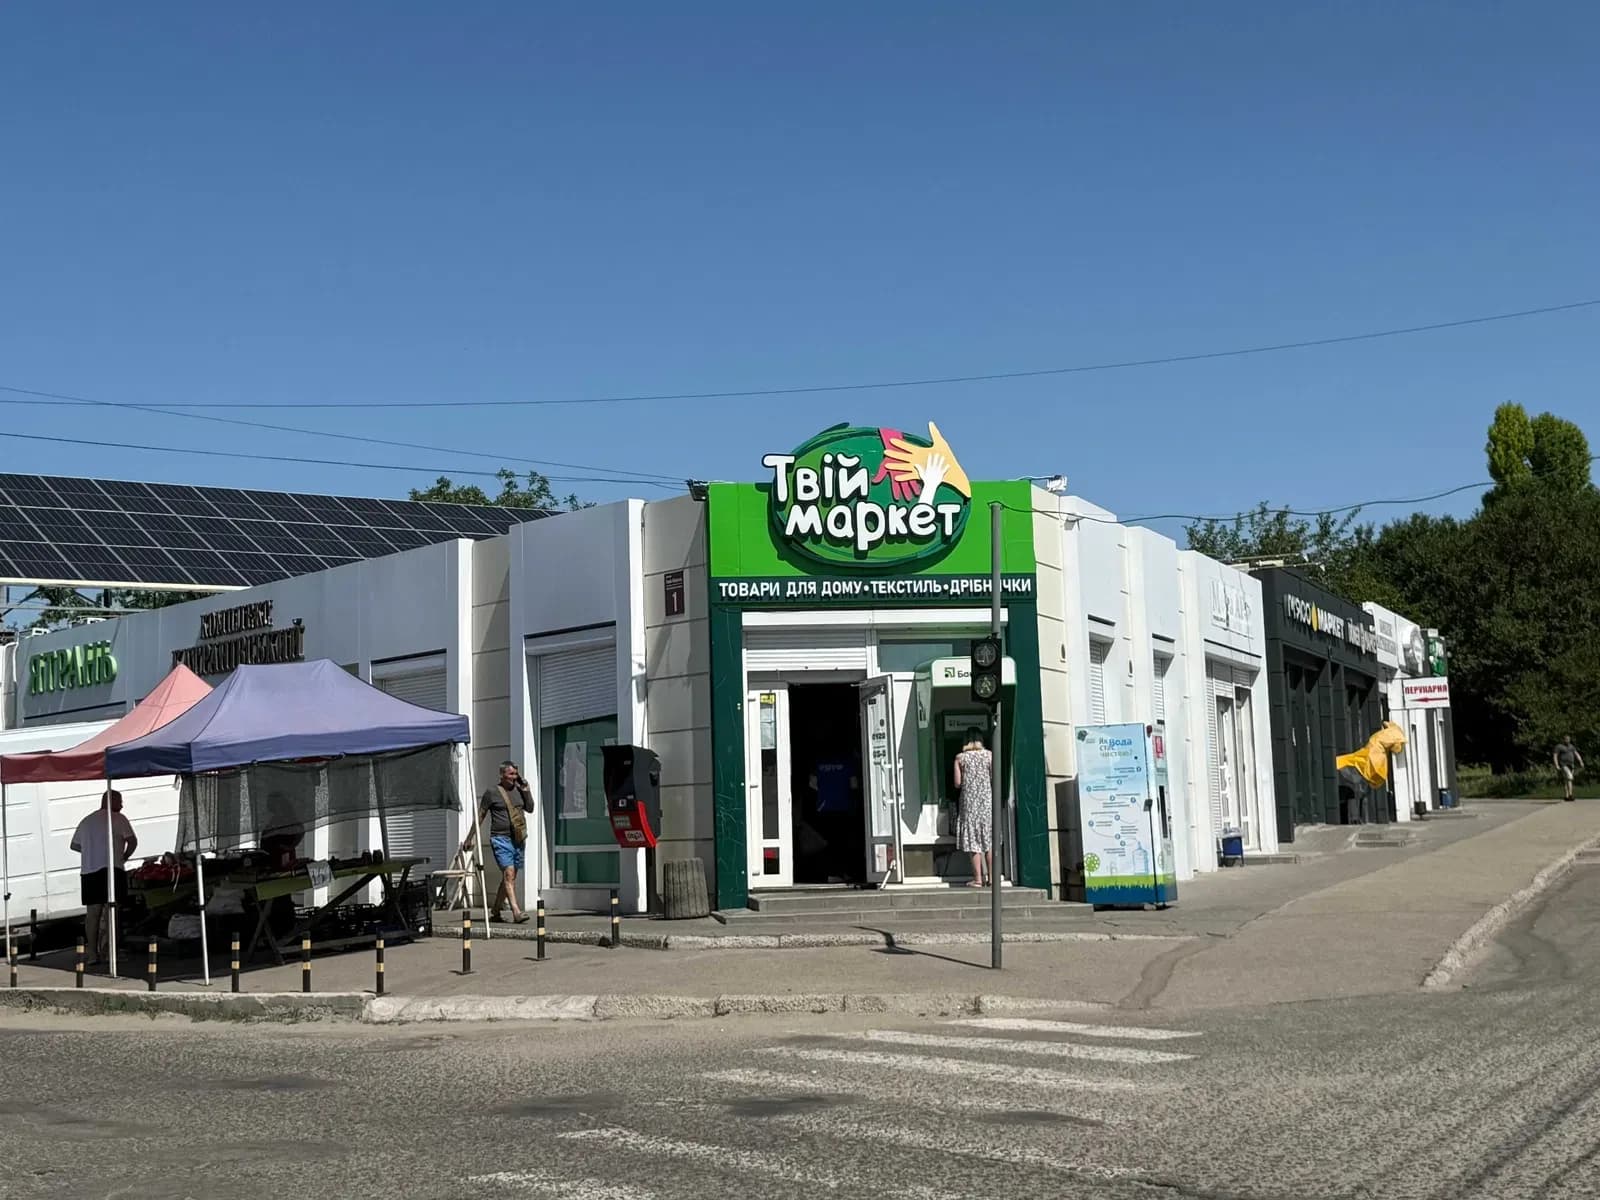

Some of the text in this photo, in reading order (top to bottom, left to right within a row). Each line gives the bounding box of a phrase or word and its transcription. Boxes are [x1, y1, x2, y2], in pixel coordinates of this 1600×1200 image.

[763, 454, 869, 502] Твій
[719, 582, 780, 597] ТОВАРИ
[786, 581, 817, 597] ДЛЯ
[671, 591, 678, 612] 1
